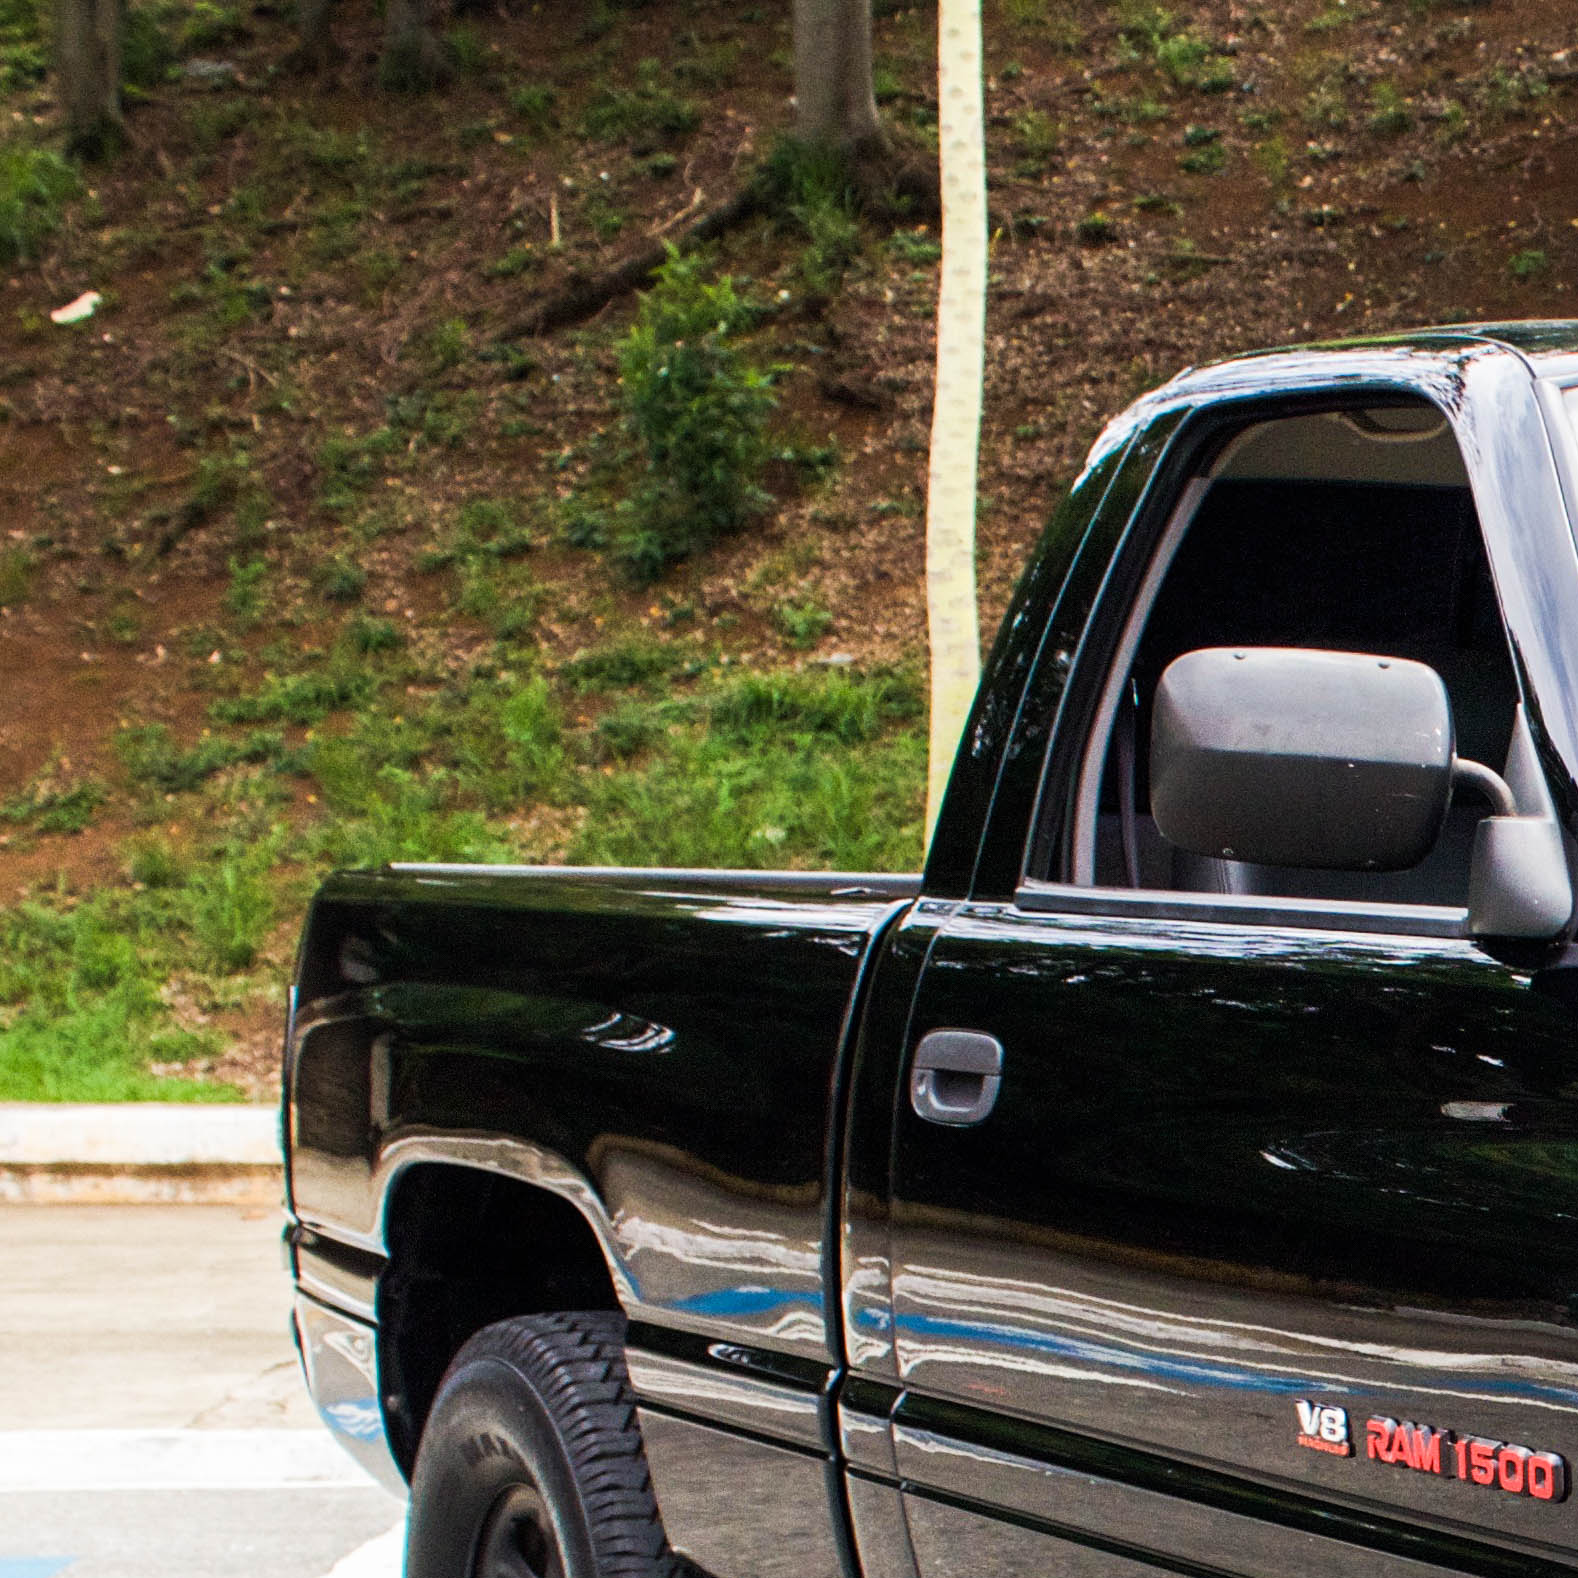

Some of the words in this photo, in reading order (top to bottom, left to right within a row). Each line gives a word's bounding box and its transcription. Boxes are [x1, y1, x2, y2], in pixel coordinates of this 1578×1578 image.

[1296, 1399, 1350, 1443] V8
[1366, 1415, 1445, 1474] RAM
[1454, 1435, 1561, 1500] 1500
